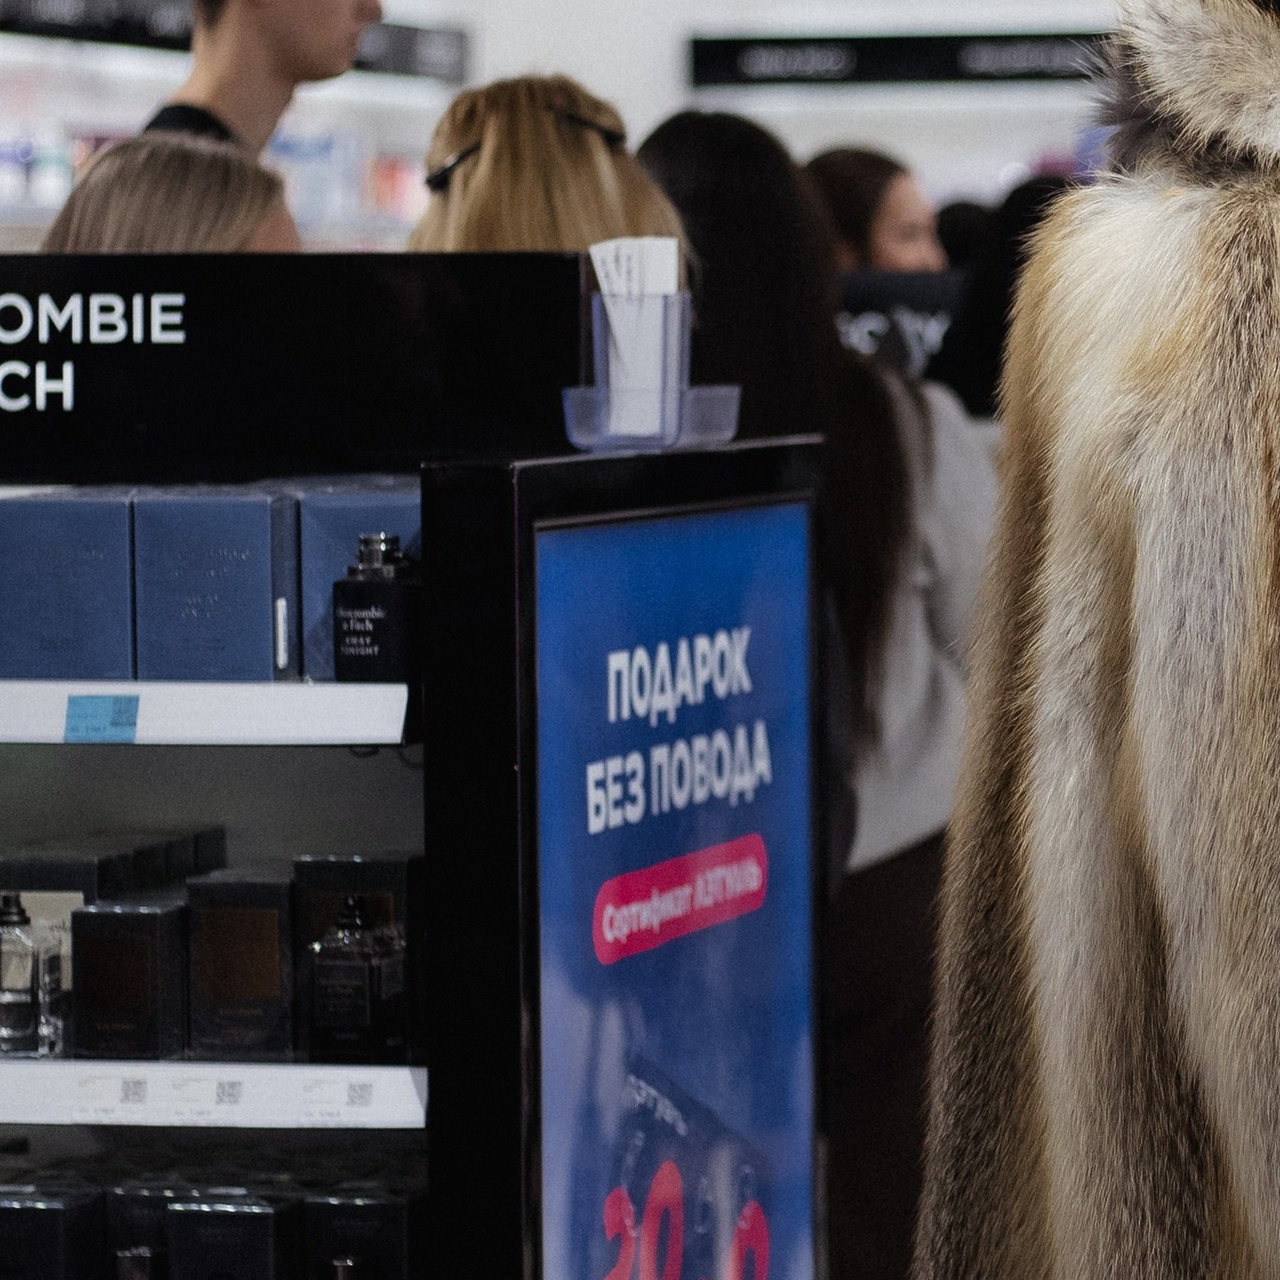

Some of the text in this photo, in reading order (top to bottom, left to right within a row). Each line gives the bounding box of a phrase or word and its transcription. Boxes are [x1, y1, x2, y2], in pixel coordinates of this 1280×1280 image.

[607, 625, 753, 727] ПОДАРОК
[586, 719, 773, 835] БЕЗ ПОВОДА
